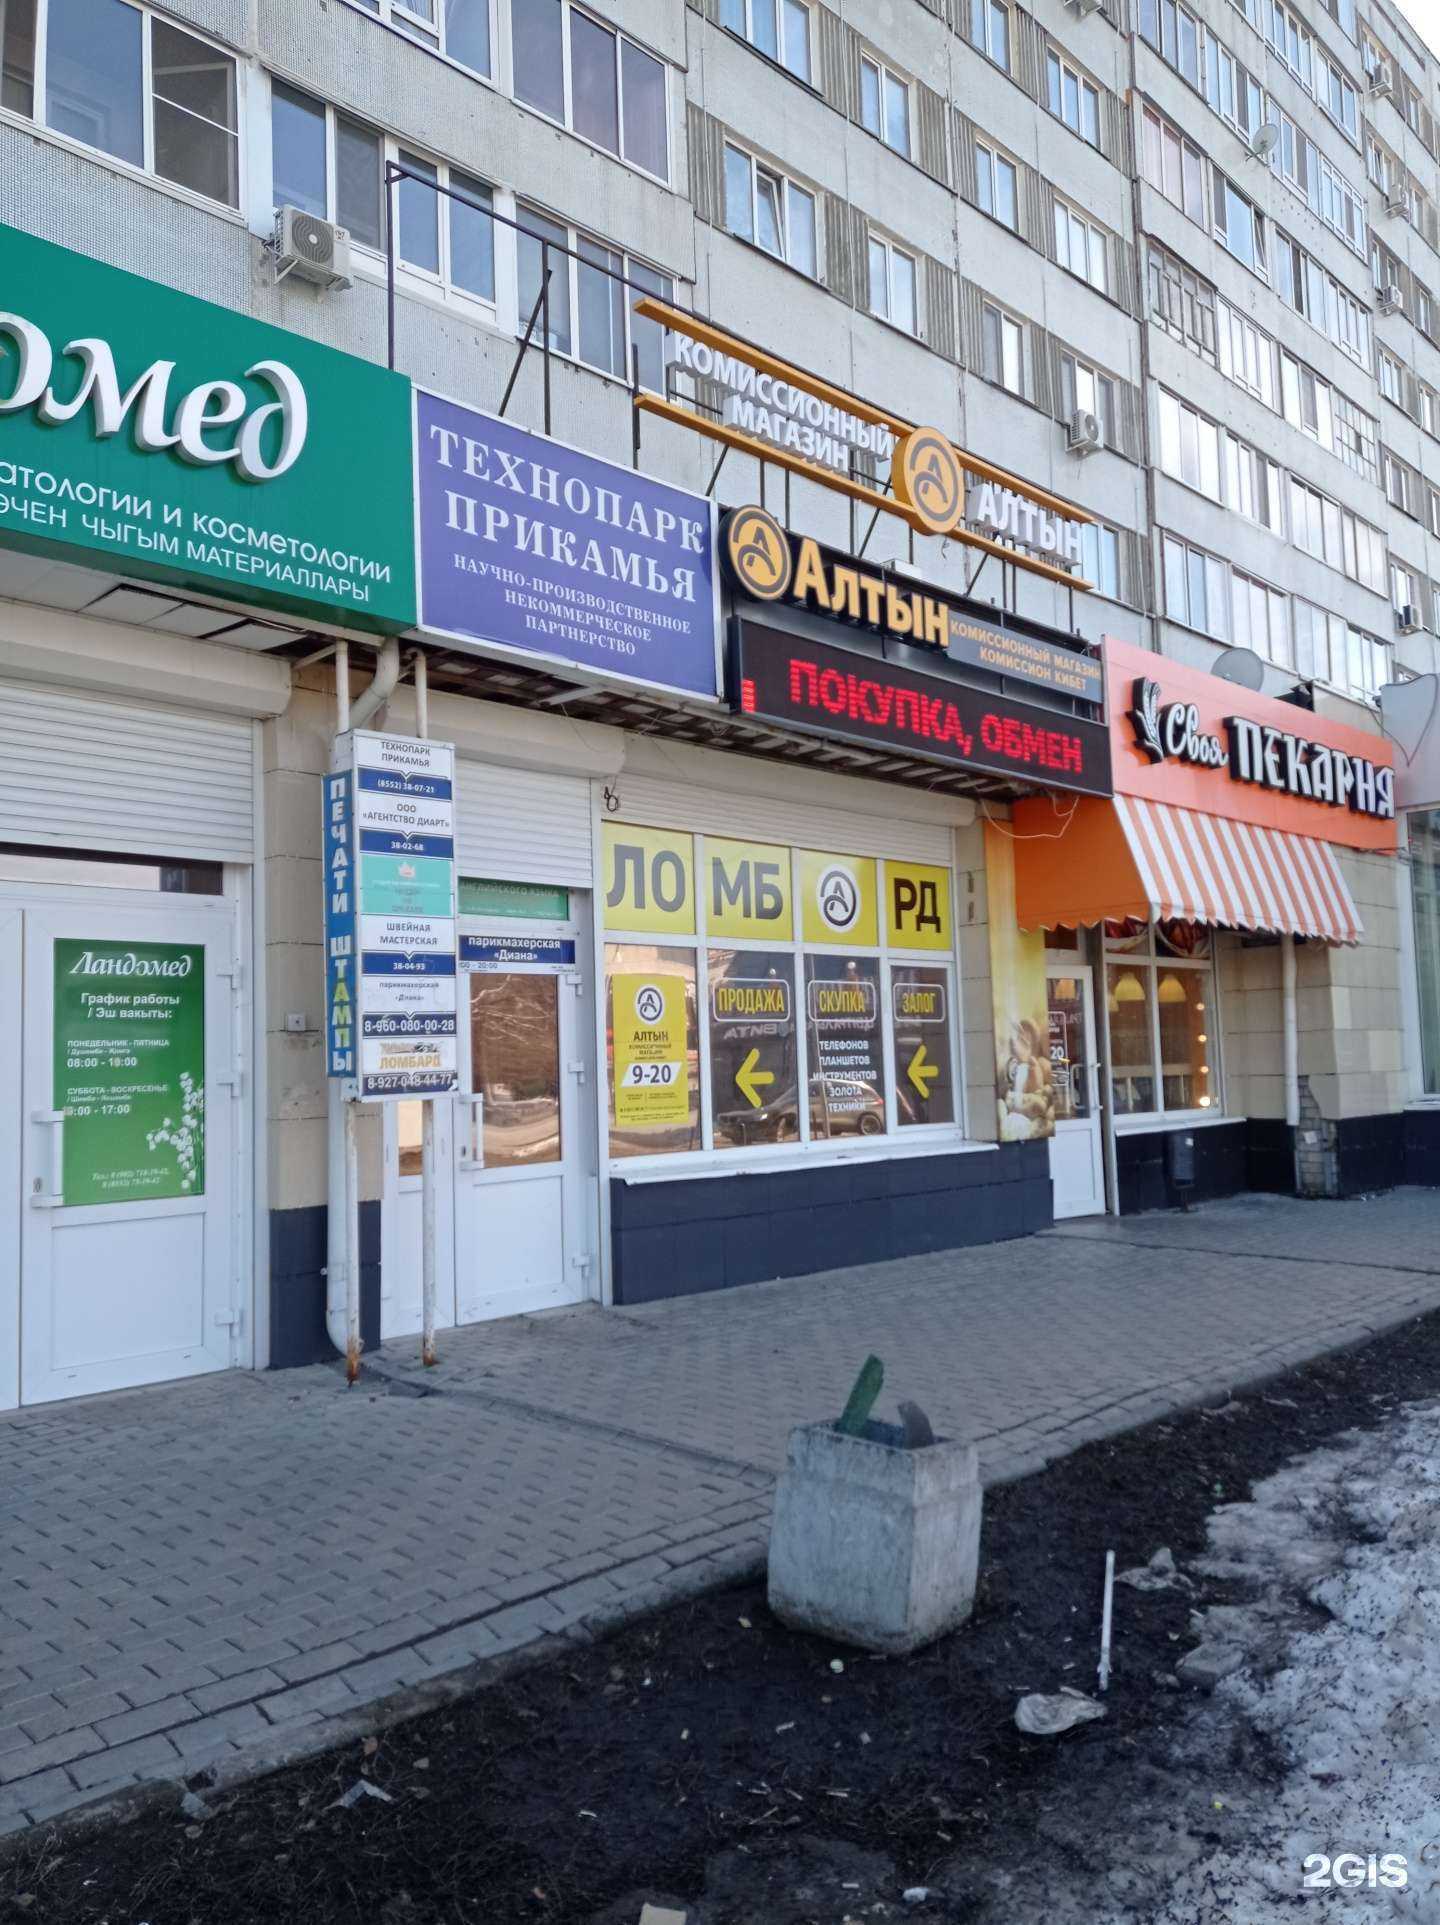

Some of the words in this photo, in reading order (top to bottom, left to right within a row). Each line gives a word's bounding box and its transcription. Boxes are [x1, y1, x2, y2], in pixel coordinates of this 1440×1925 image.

[669, 330, 893, 461] КОМИССИОННЫЙ
[729, 393, 849, 473] МАГАЗИН
[430, 424, 704, 554] ТЕХНОПАРК
[976, 482, 1082, 564] АЛТЫН
[444, 489, 696, 602] ПРИКАМЬЯ
[82, 513, 179, 555] ЧЫГЫМ
[187, 540, 369, 601] МАТЕРИАЛЛАРЫ
[453, 553, 691, 634] НАУЧНО-ПРОИЗВОДСТВЕННОЕ
[504, 588, 652, 641] НЕКОММЕРЧЕСКОЕ
[525, 614, 636, 655] ПАРТНЕРСТВО
[951, 620, 1050, 663] КОМИССИОННЫЙ
[1054, 653, 1101, 680] МАГАЗИН
[980, 646, 1051, 679] КОМИССИОН
[1055, 671, 1087, 691] КИБЕТ
[789, 659, 973, 757] ПОКУПКА,
[981, 714, 1083, 774] ОБМЕН
[381, 742, 431, 756] ТЕХНОПАРК
[382, 753, 430, 767] ПРИКАМЬЯ
[1228, 717, 1395, 819] ПЕКАРНЯ
[397, 804, 416, 812] ООО
[330, 777, 348, 913] ПЕЧАТИ
[387, 922, 430, 932] ШВЕЙНАЯ
[380, 936, 438, 945] МАСТЕРСКАЯ
[468, 937, 560, 949] парикмахерская
[494, 949, 538, 960] «Диана»
[81, 992, 130, 1006] График
[133, 993, 180, 1006] работы
[330, 936, 352, 1071] ШТАМПЫ
[718, 988, 784, 1014] ПРОДАЖА
[819, 990, 865, 1013] СКУПКА
[903, 992, 936, 1014] ЗАЛОГ
[96, 1008, 116, 1018] Эш
[633, 1031, 669, 1041] АЛТЫН
[819, 1040, 869, 1050] ТЕЛЕФОНОВ
[380, 1055, 441, 1069] ЛОМБАРД
[819, 1055, 870, 1065] ПЛАНШЕТОВ
[632, 1065, 671, 1084] 9-20
[812, 1070, 877, 1081] ИНСТРУМЕНТОВ
[67, 1087, 105, 1095] СУББОТА
[830, 1087, 862, 1097] ЗОЛОТА
[828, 1102, 865, 1112] ТЕХНИКИ
